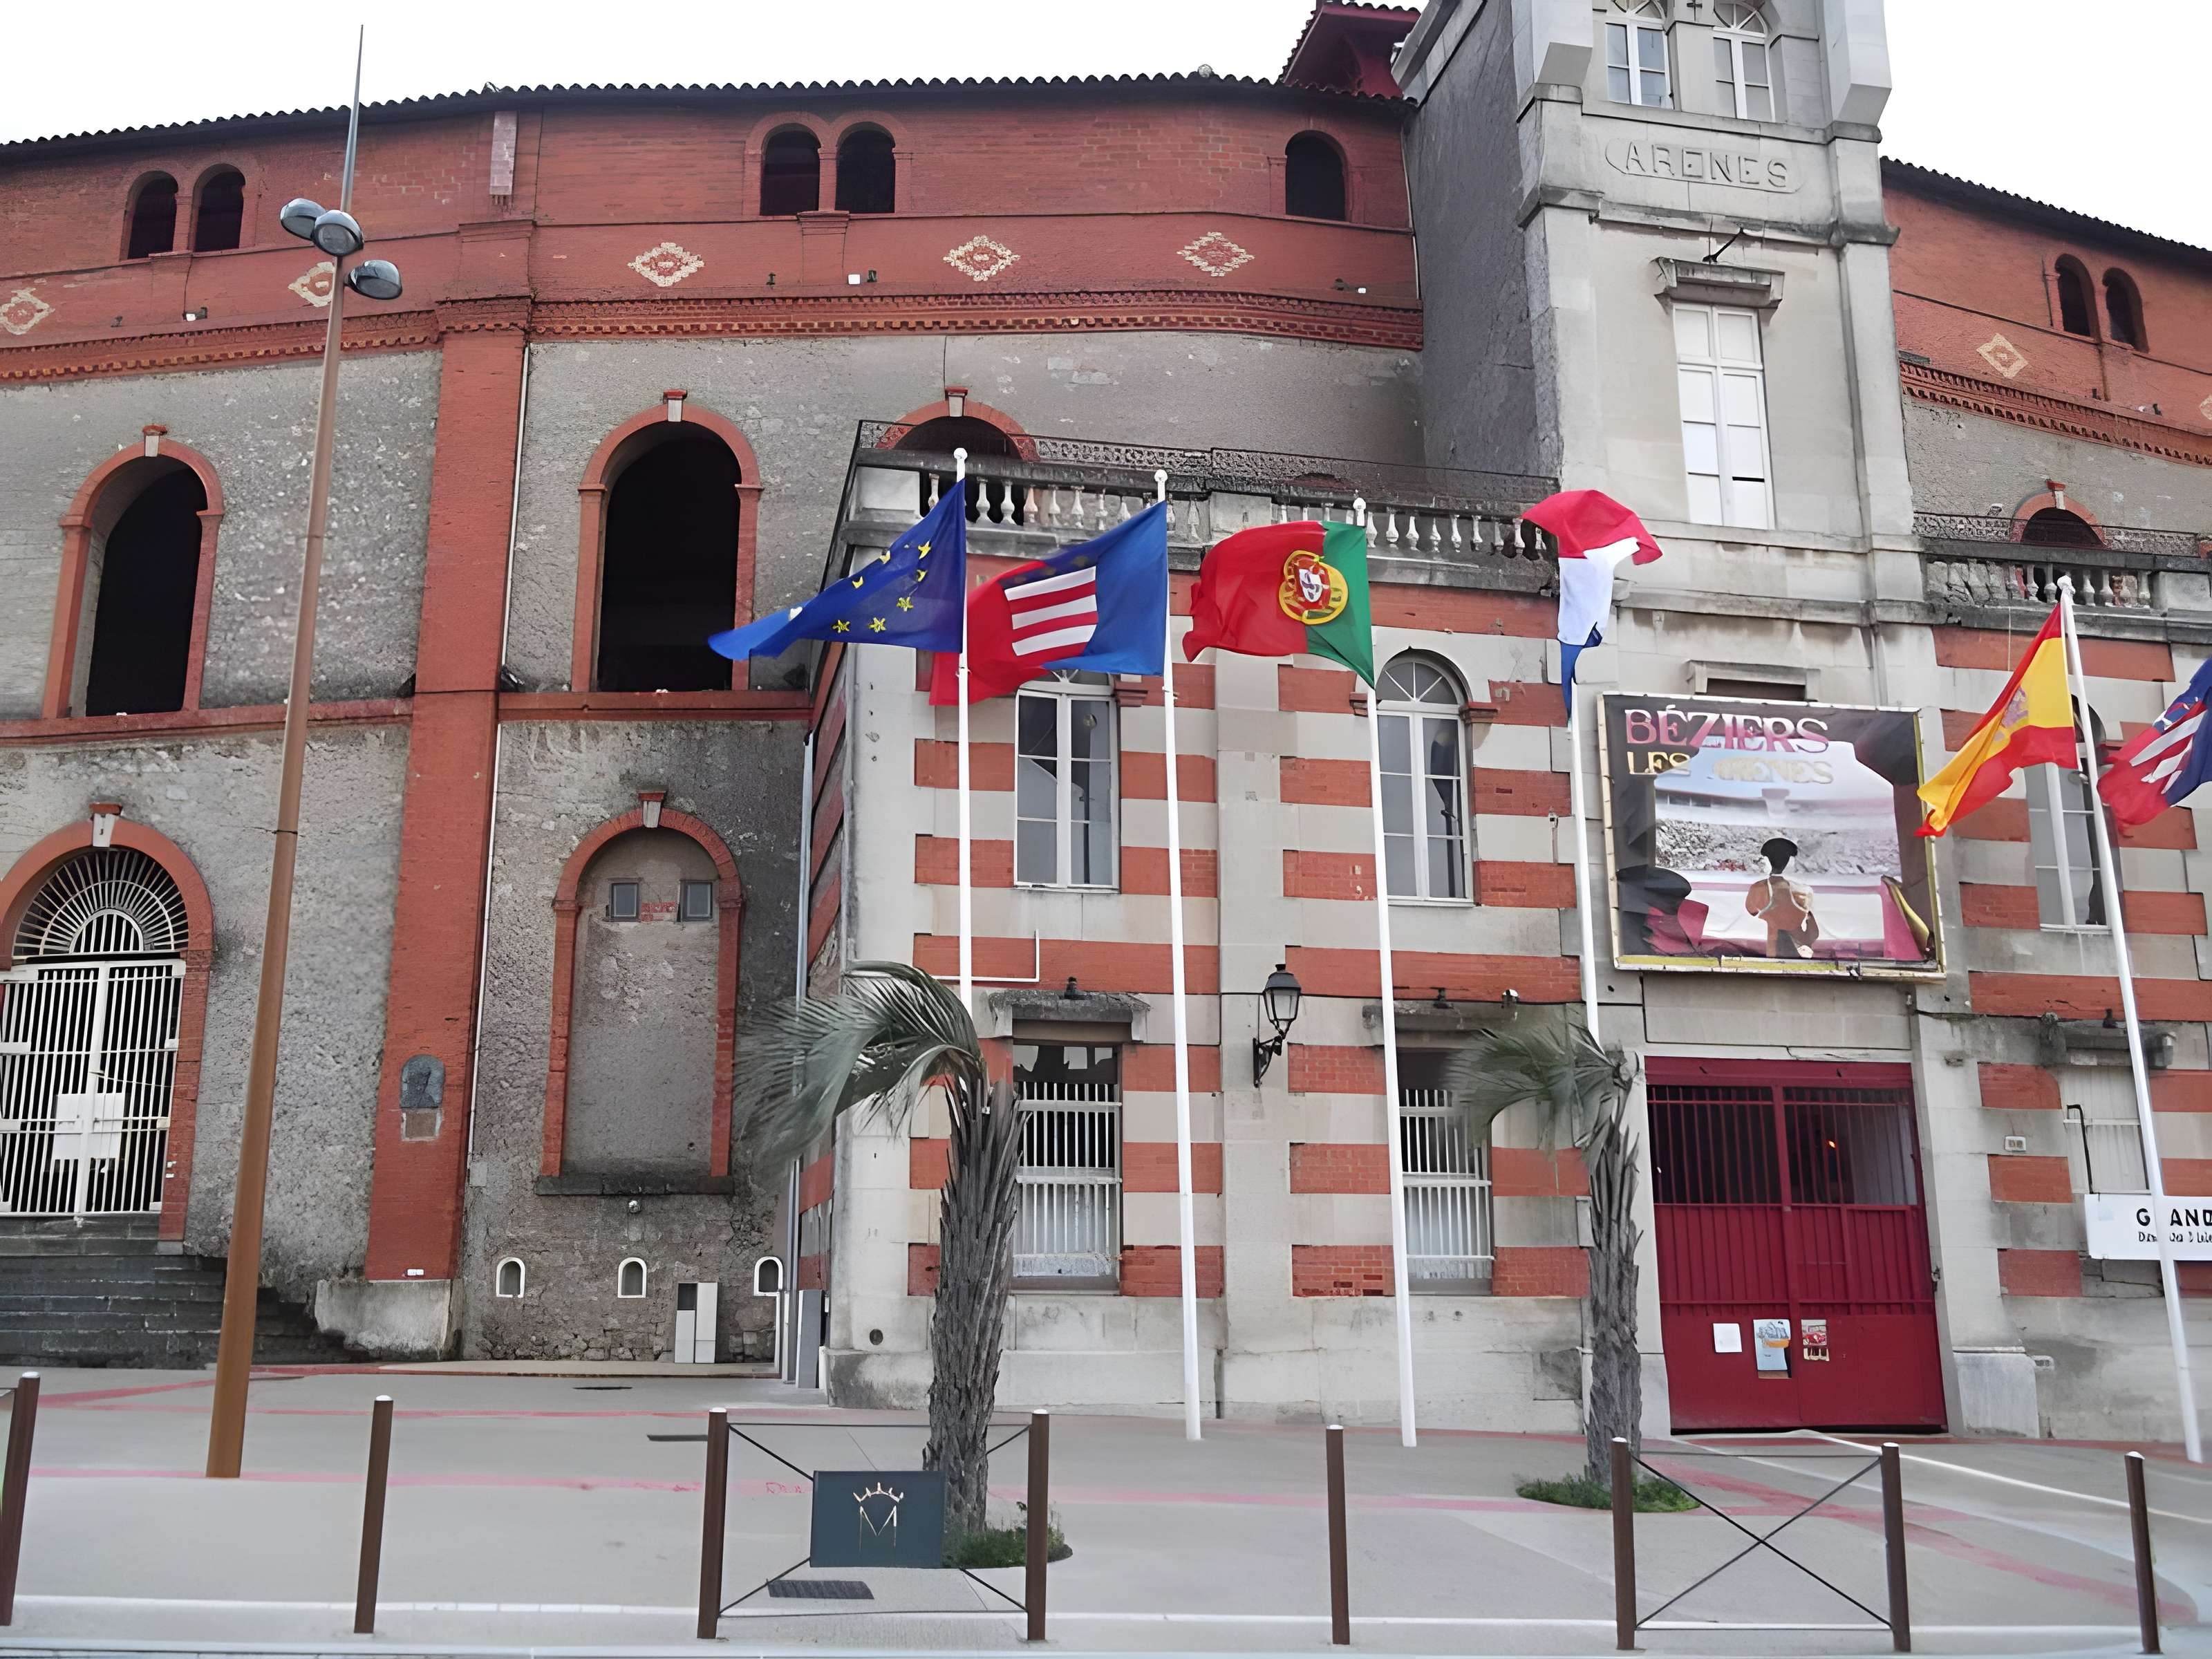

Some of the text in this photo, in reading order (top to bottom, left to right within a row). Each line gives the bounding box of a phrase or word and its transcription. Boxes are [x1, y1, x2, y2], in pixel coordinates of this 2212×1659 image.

[1624, 704, 1829, 753] BÉZIERS
[1627, 751, 1691, 775] LES
[2136, 1208, 2212, 1226] GAND
